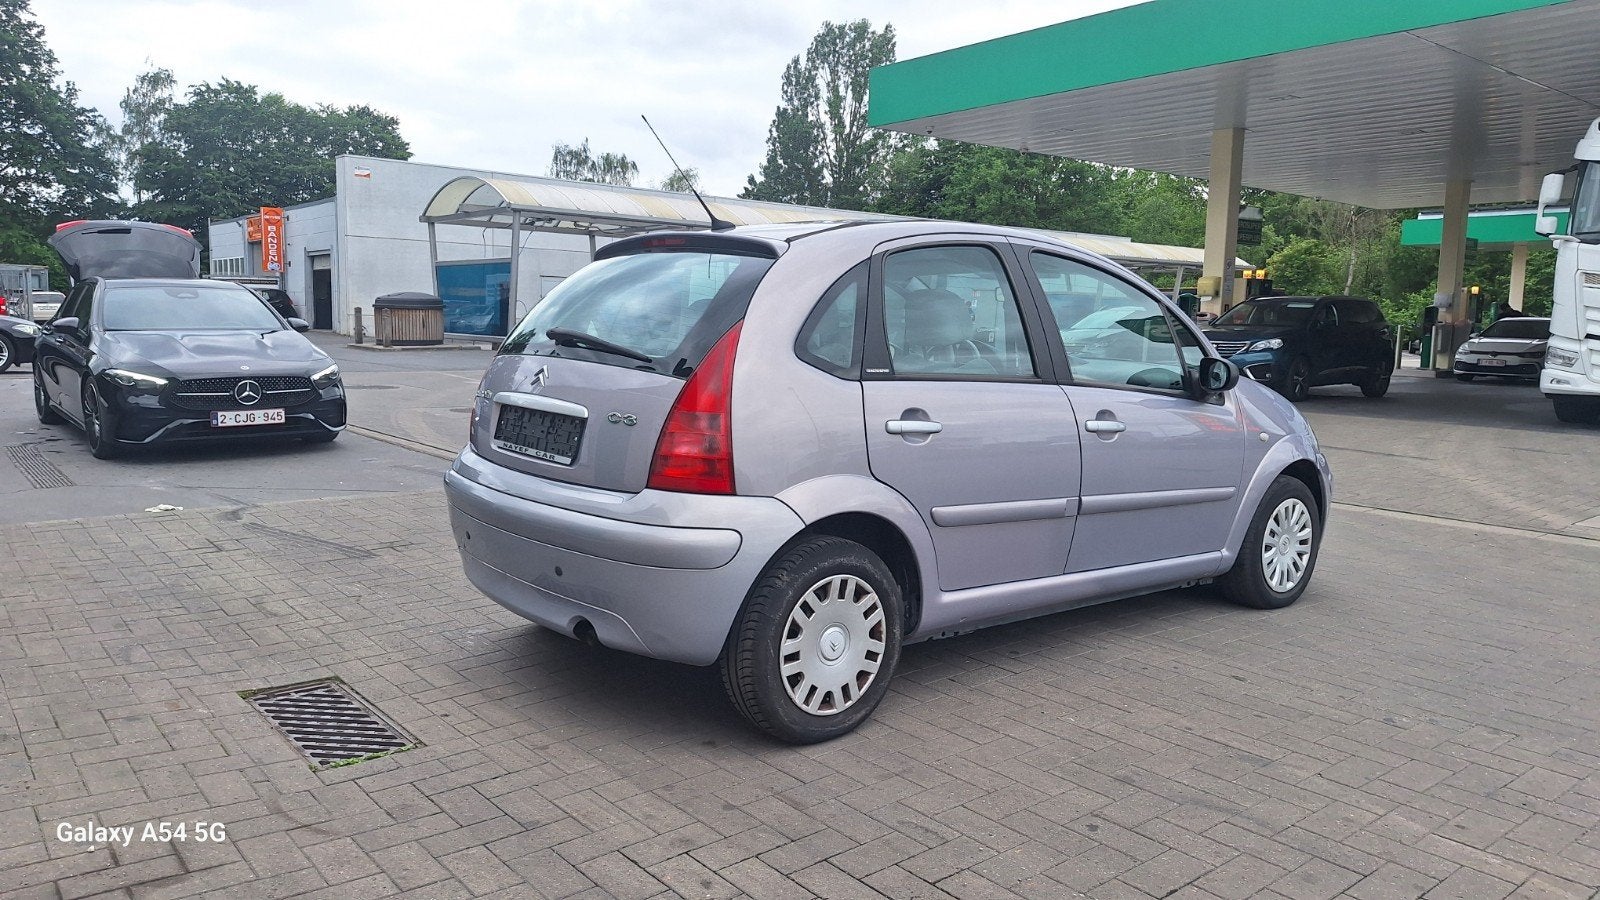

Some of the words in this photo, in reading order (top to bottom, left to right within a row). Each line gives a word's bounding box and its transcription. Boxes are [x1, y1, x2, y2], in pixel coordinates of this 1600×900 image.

[267, 225, 278, 262] BANDEN
[607, 411, 638, 426] C3
[503, 442, 529, 453] NAYEF
[535, 451, 556, 461] CAR
